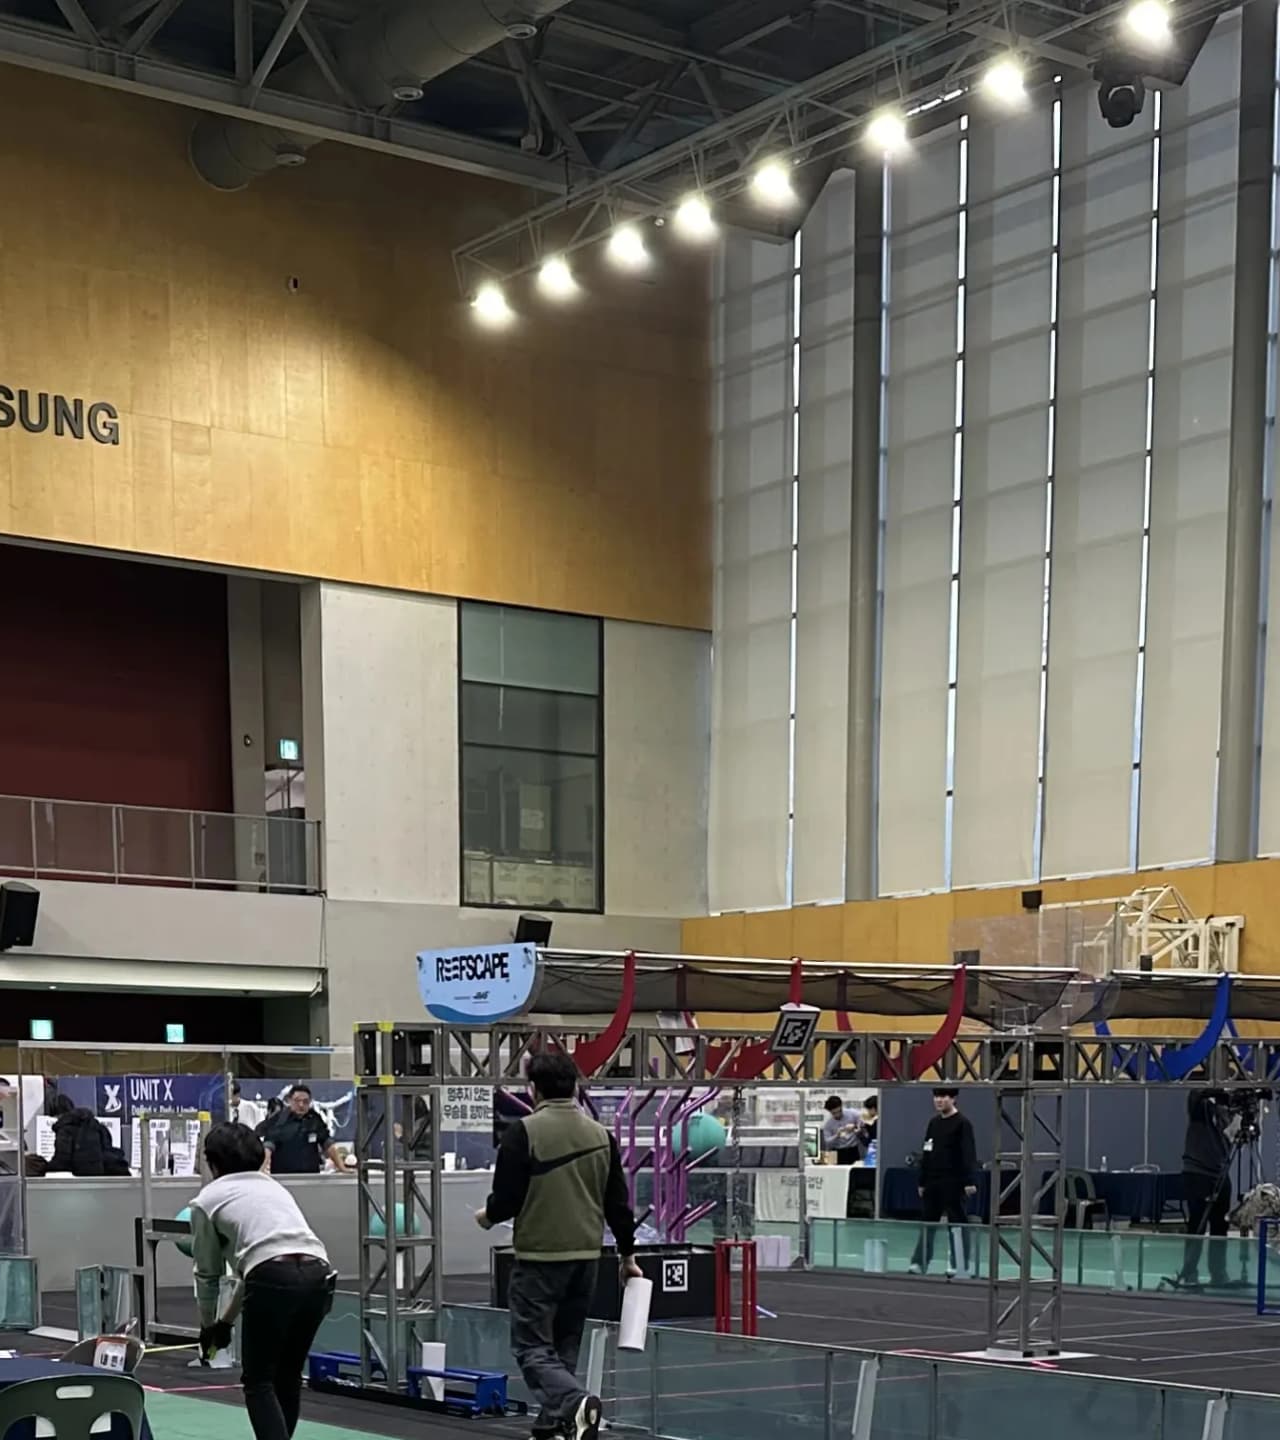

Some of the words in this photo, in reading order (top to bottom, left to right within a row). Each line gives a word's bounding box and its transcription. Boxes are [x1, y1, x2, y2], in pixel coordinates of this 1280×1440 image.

[435, 952, 510, 983] REEFSCAPE
[130, 1078, 160, 1101] UNIT
[163, 1078, 174, 1101] X
[447, 1087, 472, 1101] 멈추지
